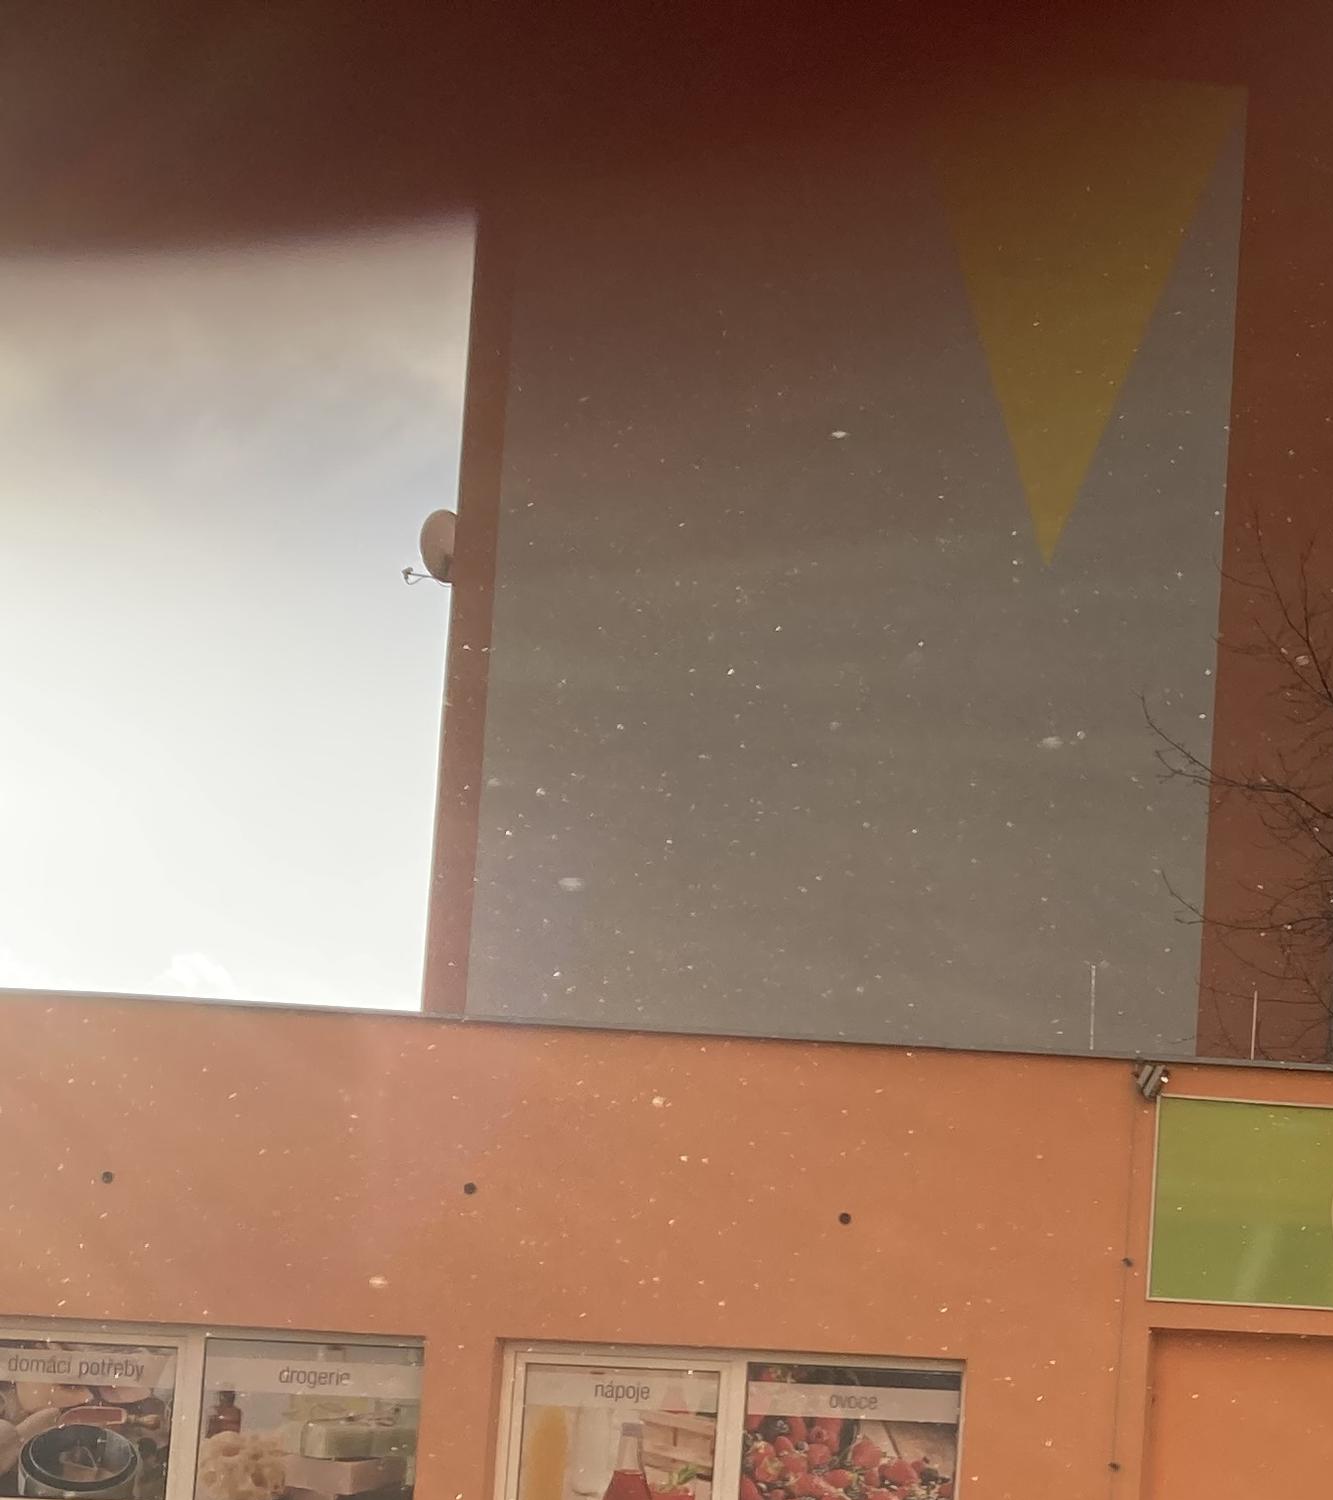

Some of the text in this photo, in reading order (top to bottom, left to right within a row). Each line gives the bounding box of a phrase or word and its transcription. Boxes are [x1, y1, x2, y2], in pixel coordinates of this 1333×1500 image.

[8, 1354, 145, 1381] domácí potřeby
[279, 1366, 351, 1388] drogerie
[594, 1381, 650, 1403] nápoje
[829, 1394, 878, 1410] ovoce
